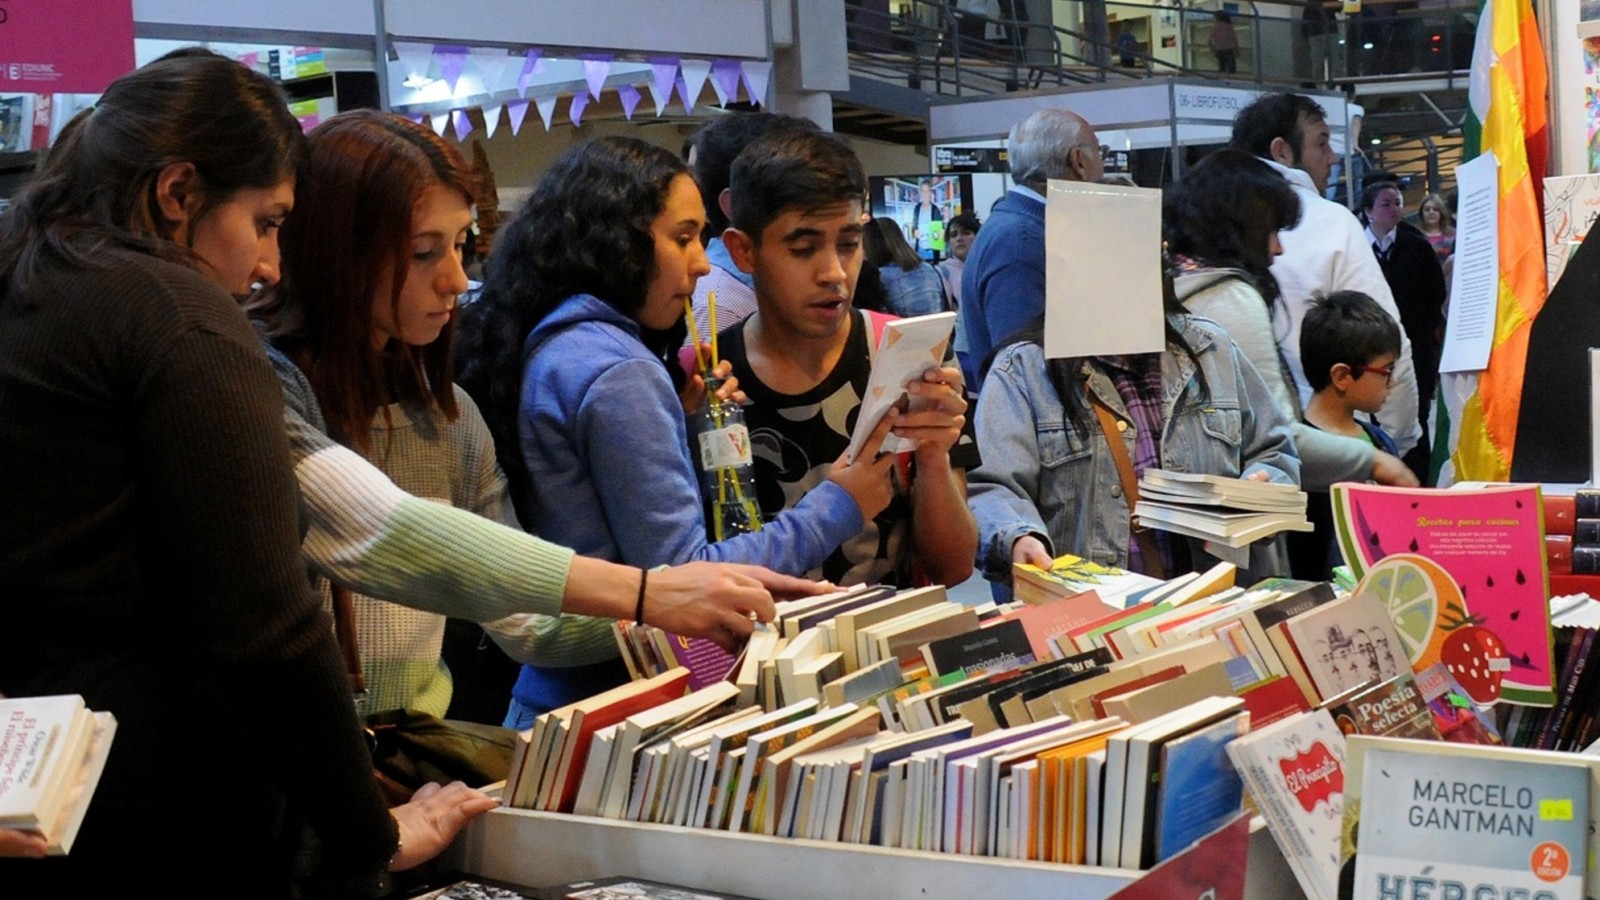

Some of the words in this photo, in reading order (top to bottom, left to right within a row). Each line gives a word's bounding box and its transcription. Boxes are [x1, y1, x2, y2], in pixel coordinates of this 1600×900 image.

[1358, 687, 1416, 721] Poesía
[1371, 702, 1418, 732] selecta
[1413, 779, 1533, 809] MARCELO
[1408, 805, 1534, 837] GANTMAN
